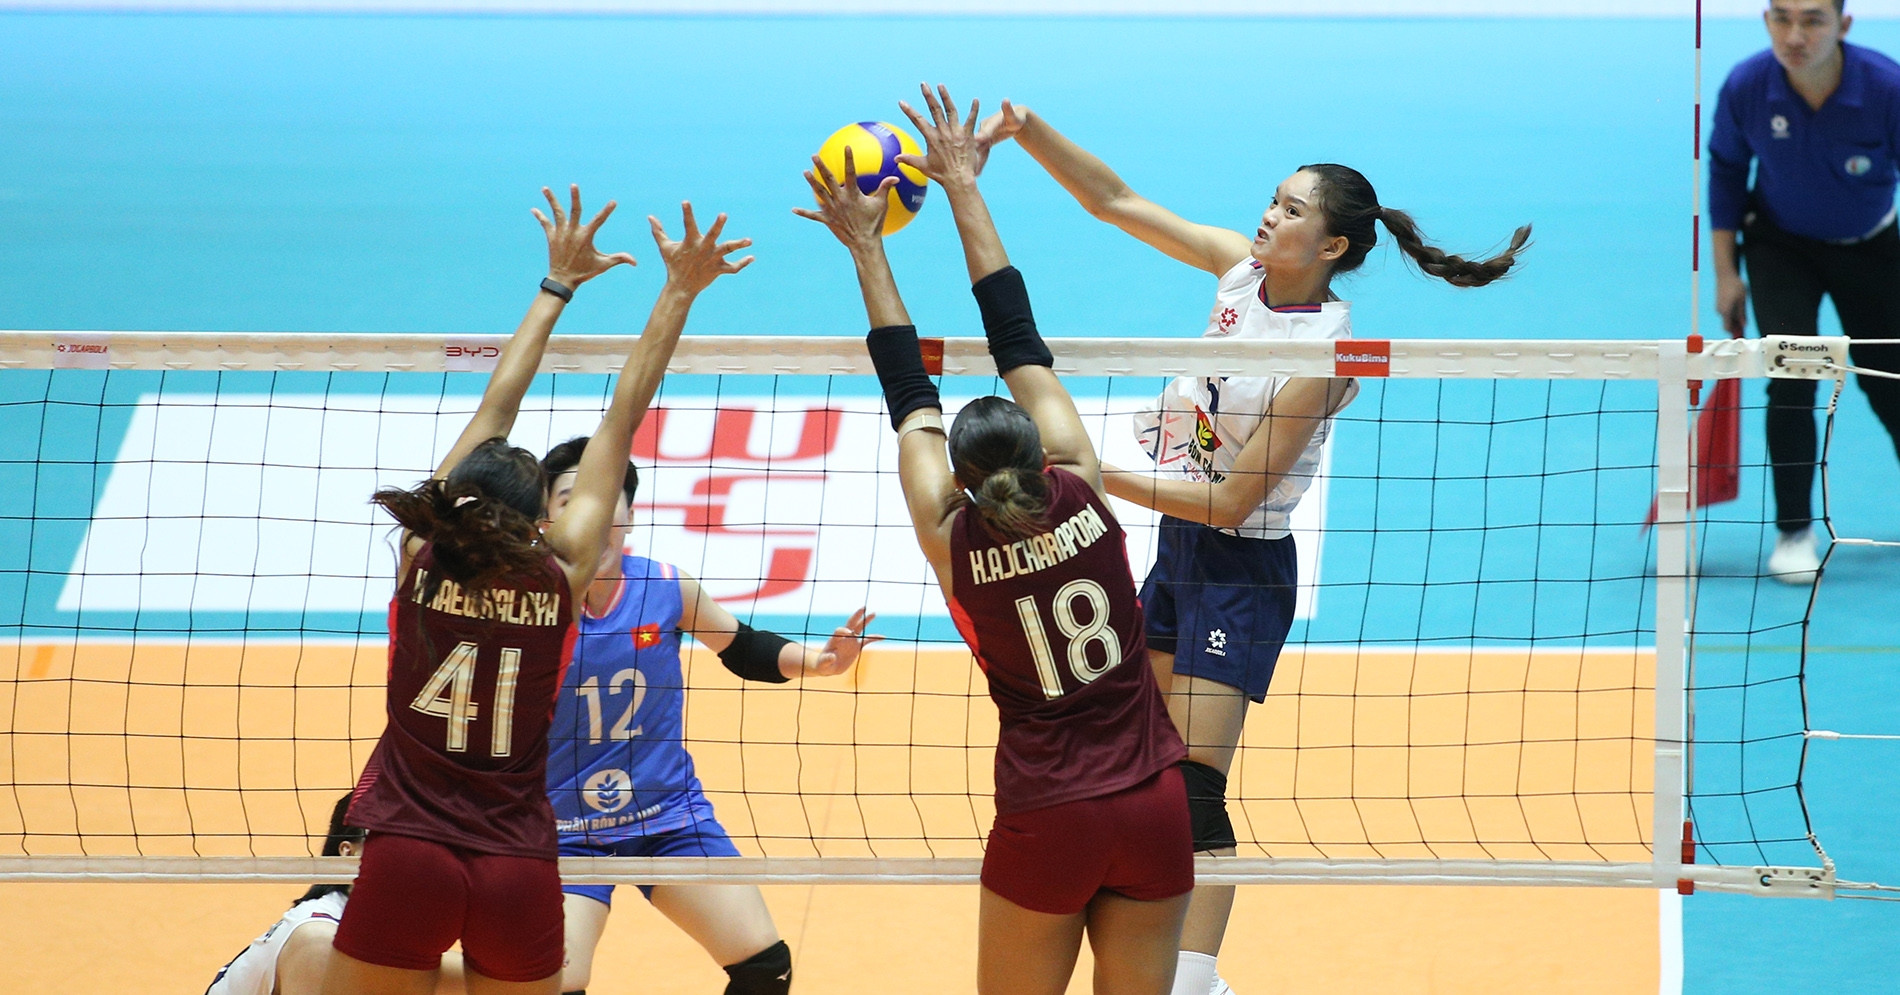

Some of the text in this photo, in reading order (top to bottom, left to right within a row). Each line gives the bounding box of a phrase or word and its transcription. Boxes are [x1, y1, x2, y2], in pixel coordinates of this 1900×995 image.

[446, 346, 499, 357] BYD
[1336, 353, 1388, 363] KukuBima
[1790, 343, 1828, 352] Senoh
[969, 503, 1108, 585] K.AJCHARAPORN
[1015, 578, 1122, 701] 18
[409, 641, 522, 757] 41
[575, 668, 647, 745] 12
